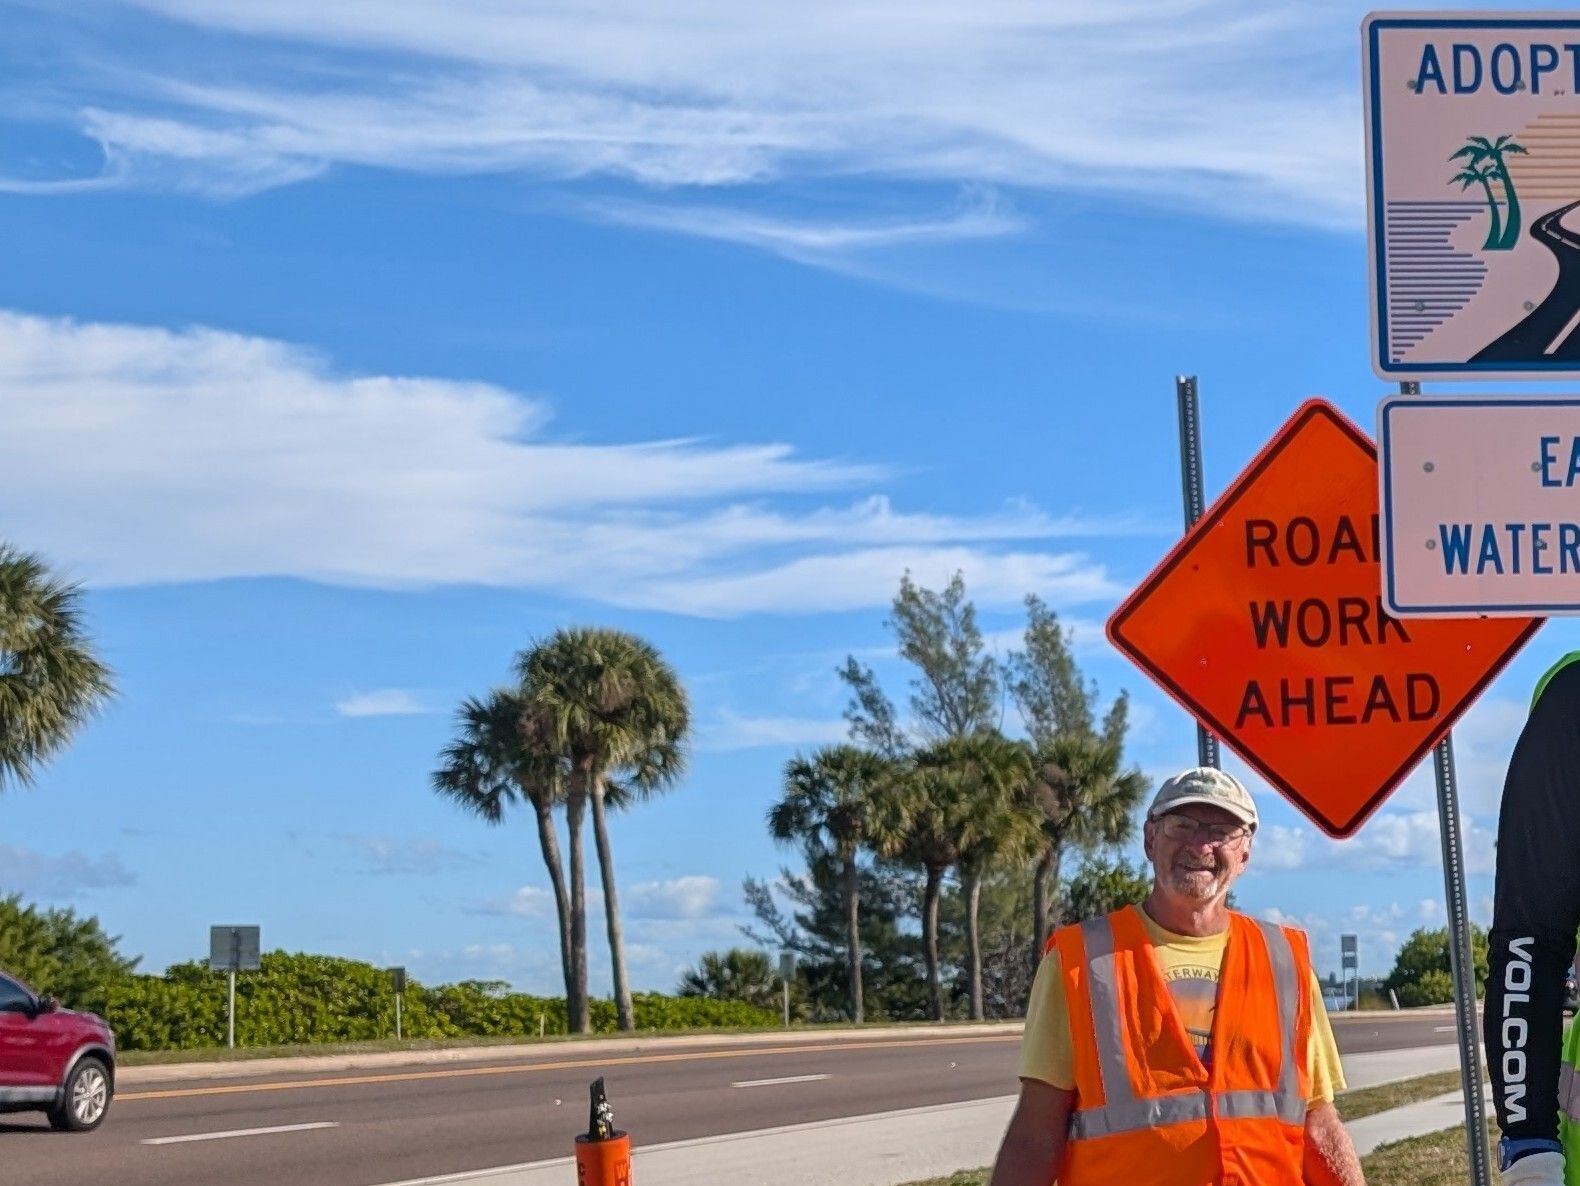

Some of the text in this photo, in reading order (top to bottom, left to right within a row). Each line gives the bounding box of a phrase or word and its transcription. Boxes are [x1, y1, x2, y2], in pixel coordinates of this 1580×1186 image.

[1245, 513, 1381, 568] ROA
[1249, 596, 1411, 649] WORK
[1234, 672, 1441, 729] AHEAD
[1502, 936, 1536, 1125] VOLCOM
